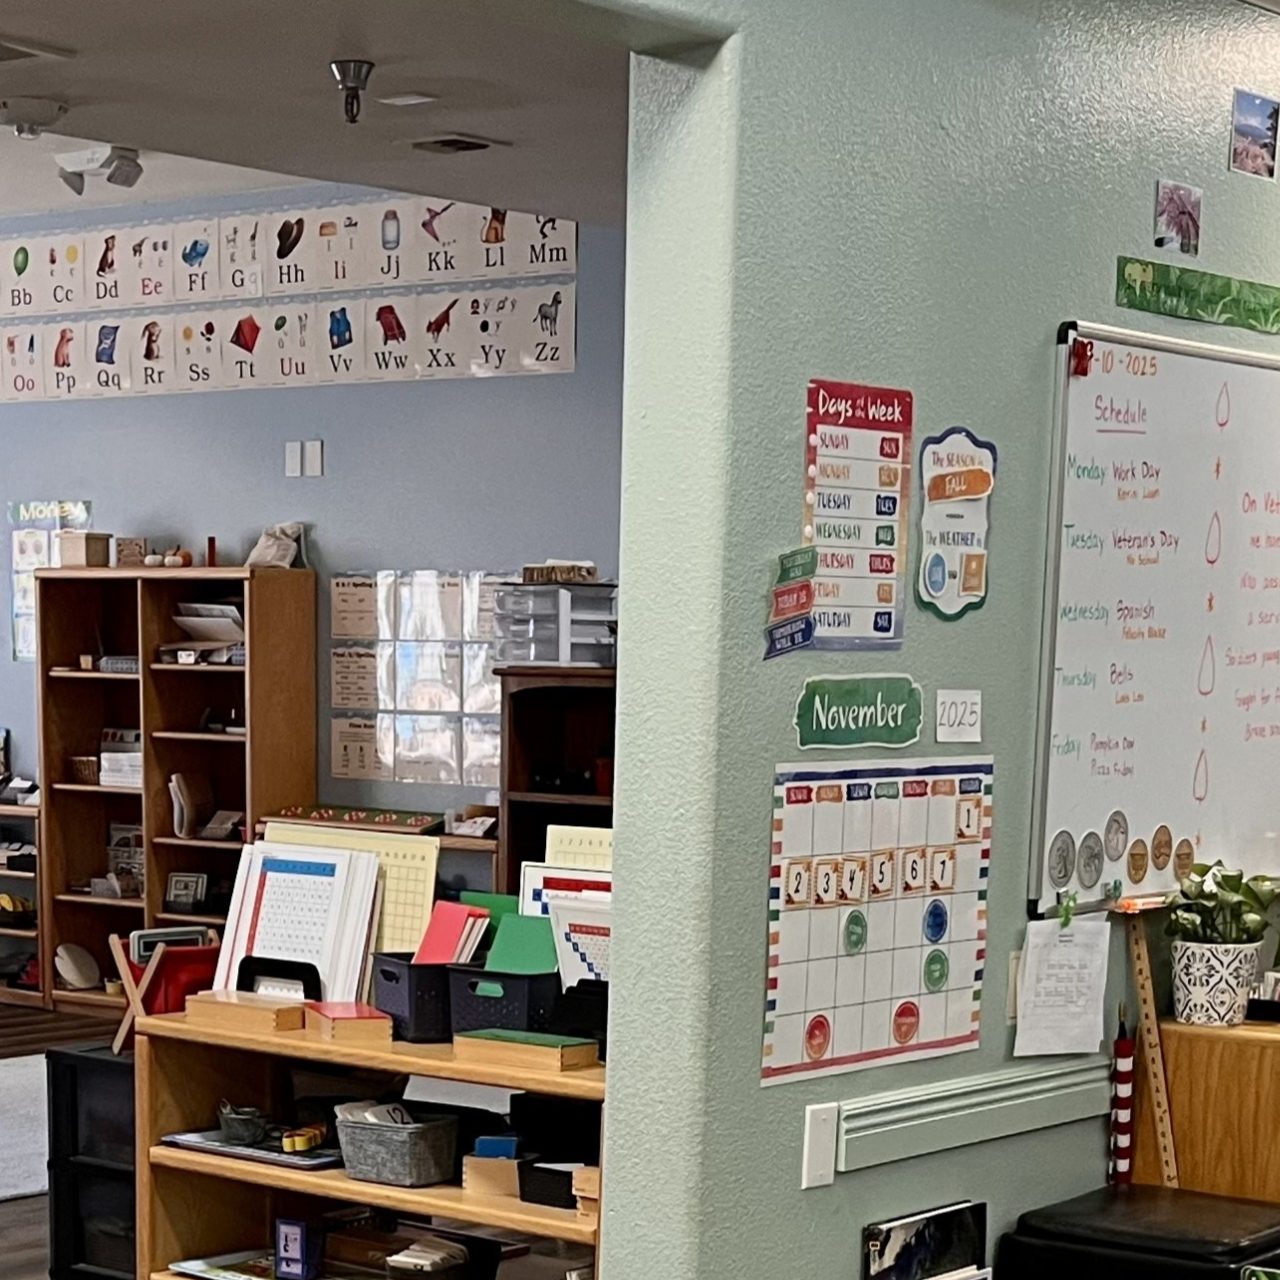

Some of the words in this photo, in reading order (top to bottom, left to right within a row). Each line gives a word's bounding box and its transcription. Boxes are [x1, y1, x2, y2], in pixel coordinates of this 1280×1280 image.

[10, 288, 32, 306] Bb
[53, 285, 74, 303] Cc
[95, 281, 119, 300] Dd
[141, 277, 163, 296] Ee
[187, 272, 207, 293] Ff
[278, 265, 305, 284] Hh
[333, 261, 347, 280] Ii
[380, 256, 400, 277] Jj
[427, 251, 456, 272] Kk
[484, 247, 505, 268] Ll
[529, 244, 568, 264] Mm
[13, 375, 35, 393] Oo
[55, 372, 76, 394] Pp
[96, 370, 121, 390] Qq
[143, 366, 165, 385] Rr
[189, 364, 210, 382] Ss
[235, 360, 255, 379] Tt
[280, 357, 306, 376] Uu
[329, 354, 353, 374] Vv
[374, 350, 409, 370] Ww
[427, 348, 457, 368] Xx
[481, 345, 507, 368] Yy
[535, 342, 560, 362] Zz
[818, 388, 852, 424] Days
[867, 403, 903, 423] Week
[1095, 394, 1147, 424] Schedule
[819, 433, 849, 450] SUNDAY
[818, 463, 851, 480] MONDAY
[1066, 453, 1105, 485] Monday
[1112, 460, 1136, 481] Work
[1142, 461, 1160, 481] Day
[945, 476, 966, 492] FALL
[817, 492, 851, 510] TUESDAY
[816, 524, 861, 541] WEDNESDAY
[1064, 523, 1104, 557] Tuesday
[819, 553, 854, 569] HURSDAY
[1117, 598, 1154, 624] Spanish
[813, 691, 907, 731] November
[938, 700, 979, 728] 2025
[965, 808, 971, 829] 1
[794, 872, 802, 894] 2
[823, 872, 831, 894] 3
[878, 861, 885, 883] 5
[911, 859, 918, 880] 6
